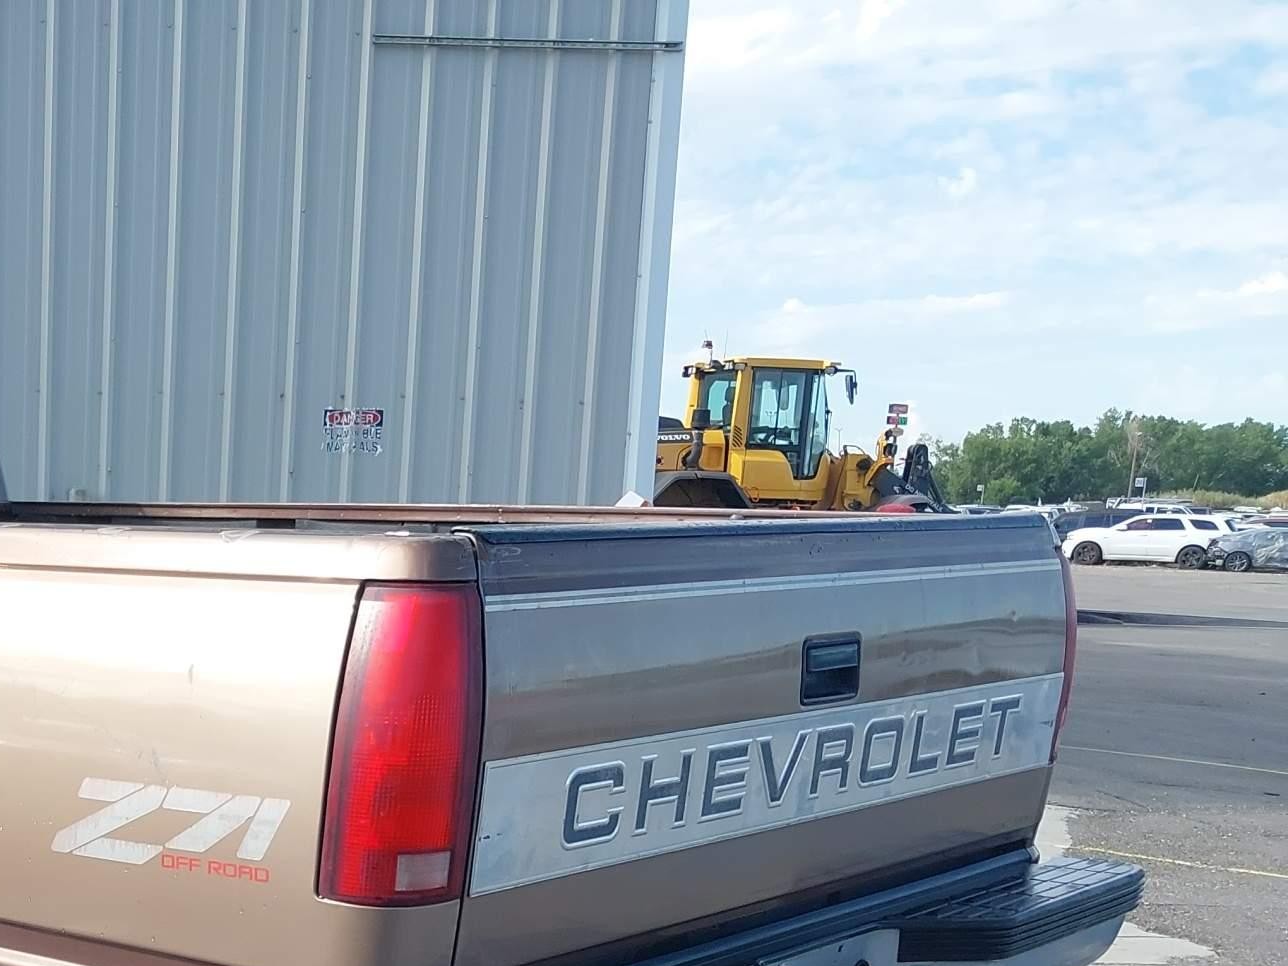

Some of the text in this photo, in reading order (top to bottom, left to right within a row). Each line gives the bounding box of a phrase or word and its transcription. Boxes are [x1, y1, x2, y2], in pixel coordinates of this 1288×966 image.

[333, 413, 374, 425] DANGER
[324, 428, 382, 440] FLAMBLE
[326, 441, 379, 453] MAALS
[561, 693, 1025, 851] CHEVROLET
[50, 776, 292, 865] Z71
[161, 854, 270, 884] OFF ROAD
